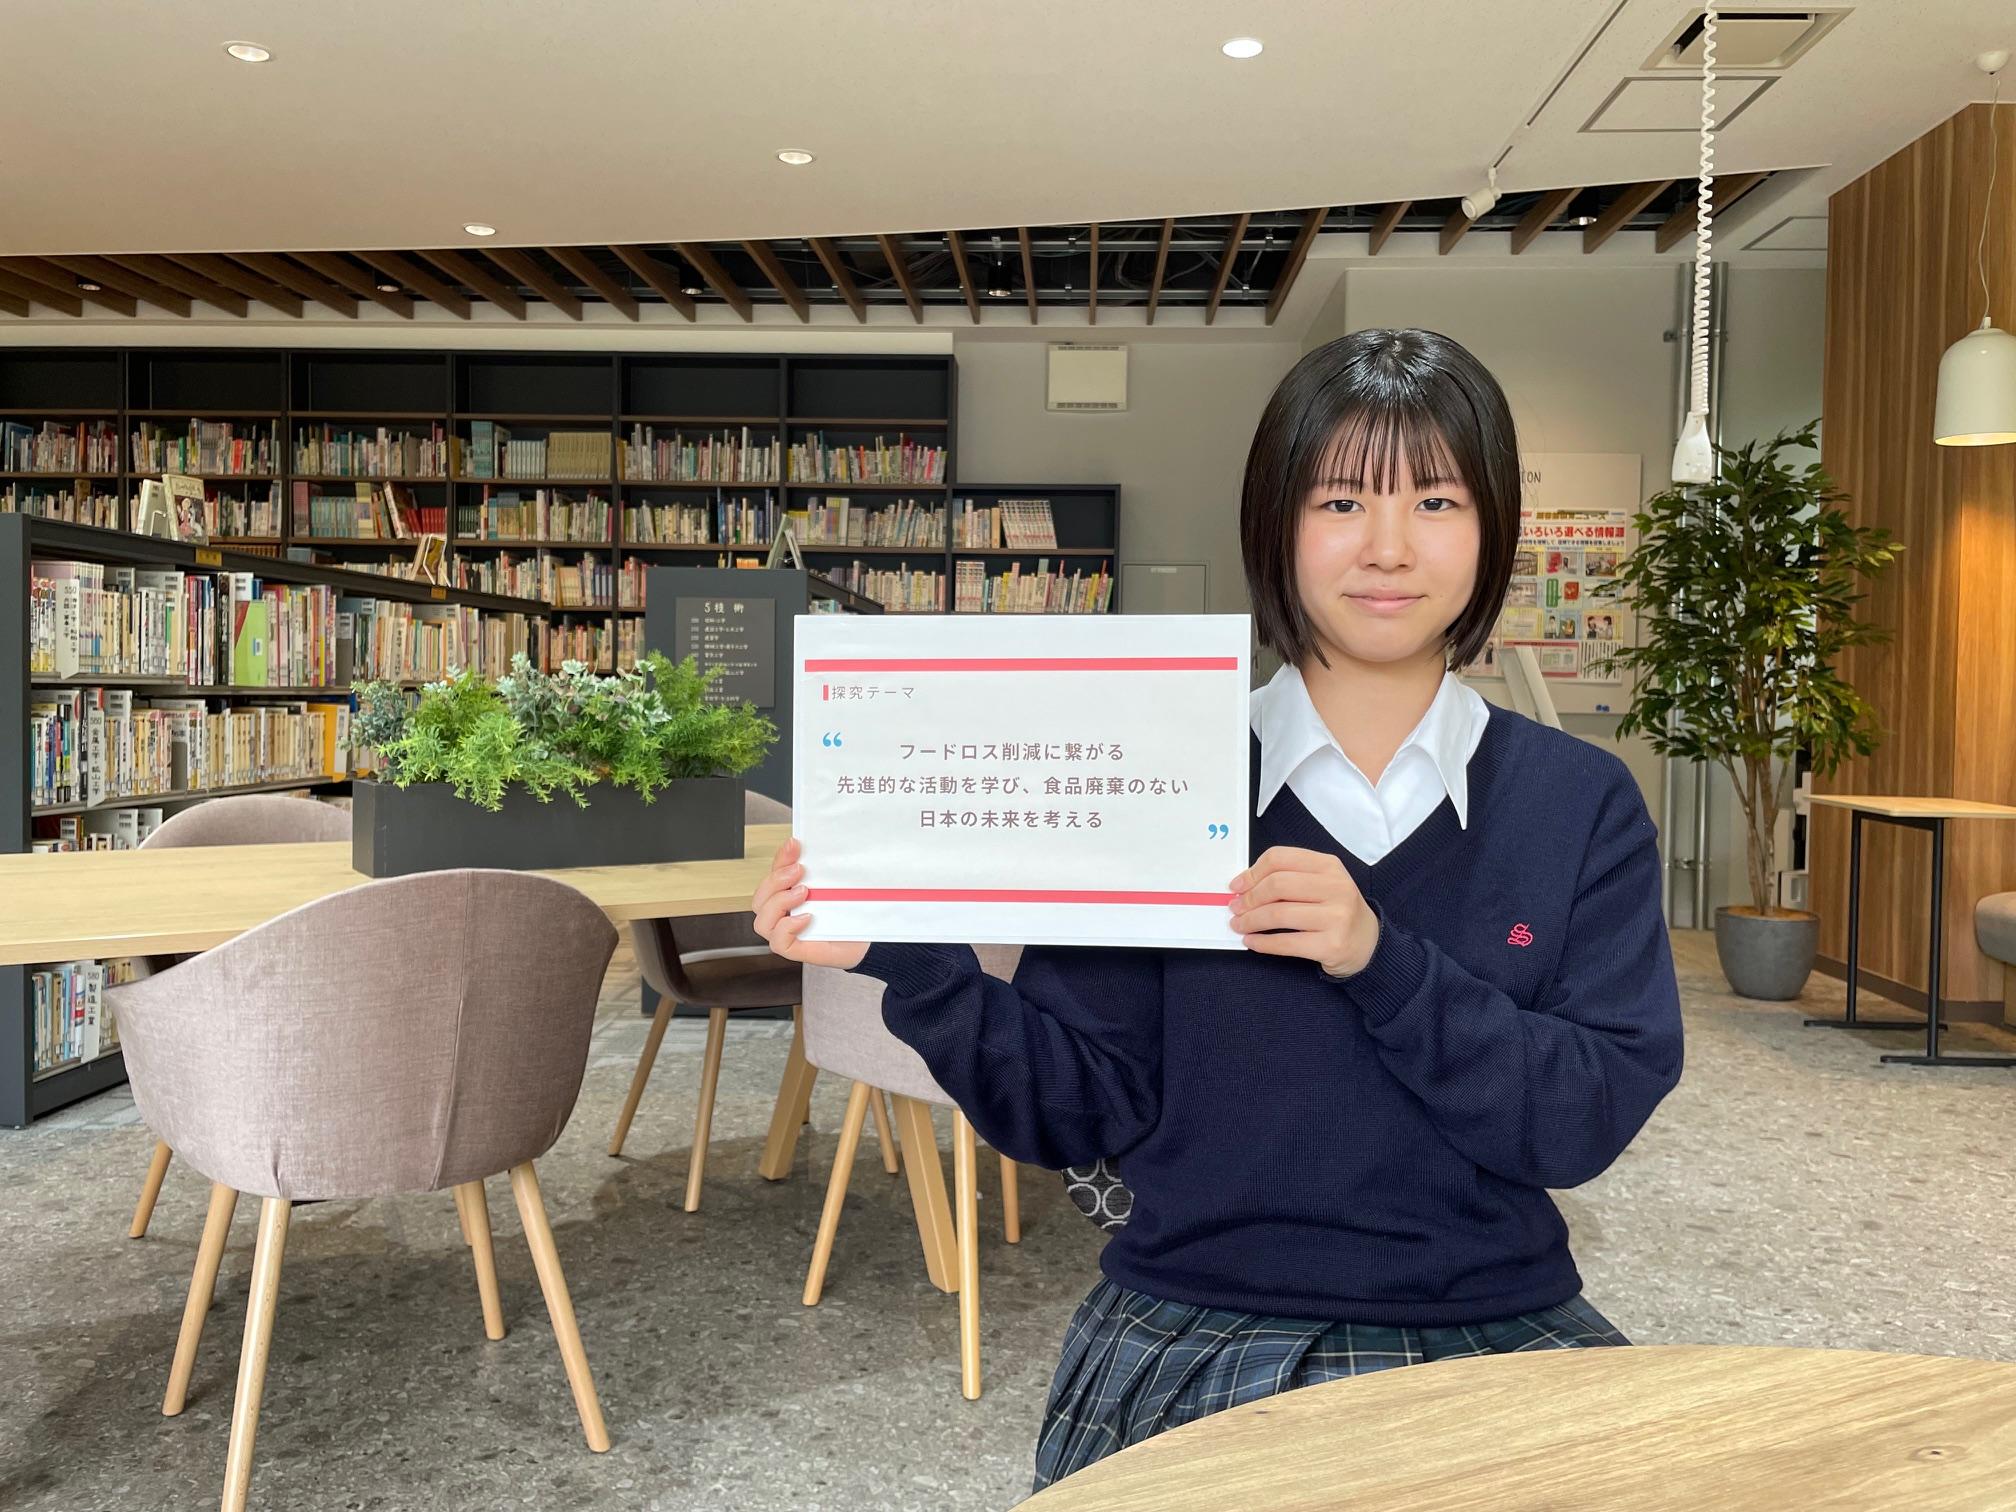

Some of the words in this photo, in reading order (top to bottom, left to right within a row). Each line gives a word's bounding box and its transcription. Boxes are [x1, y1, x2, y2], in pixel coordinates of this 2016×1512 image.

[832, 686, 915, 700] 探究テーマ
[899, 742, 1125, 761] フードロス削減に繋がる
[837, 775, 1189, 796] 先進的な活動を学び、食品廃棄のない
[920, 809, 1103, 829] 日本の未来を考える
